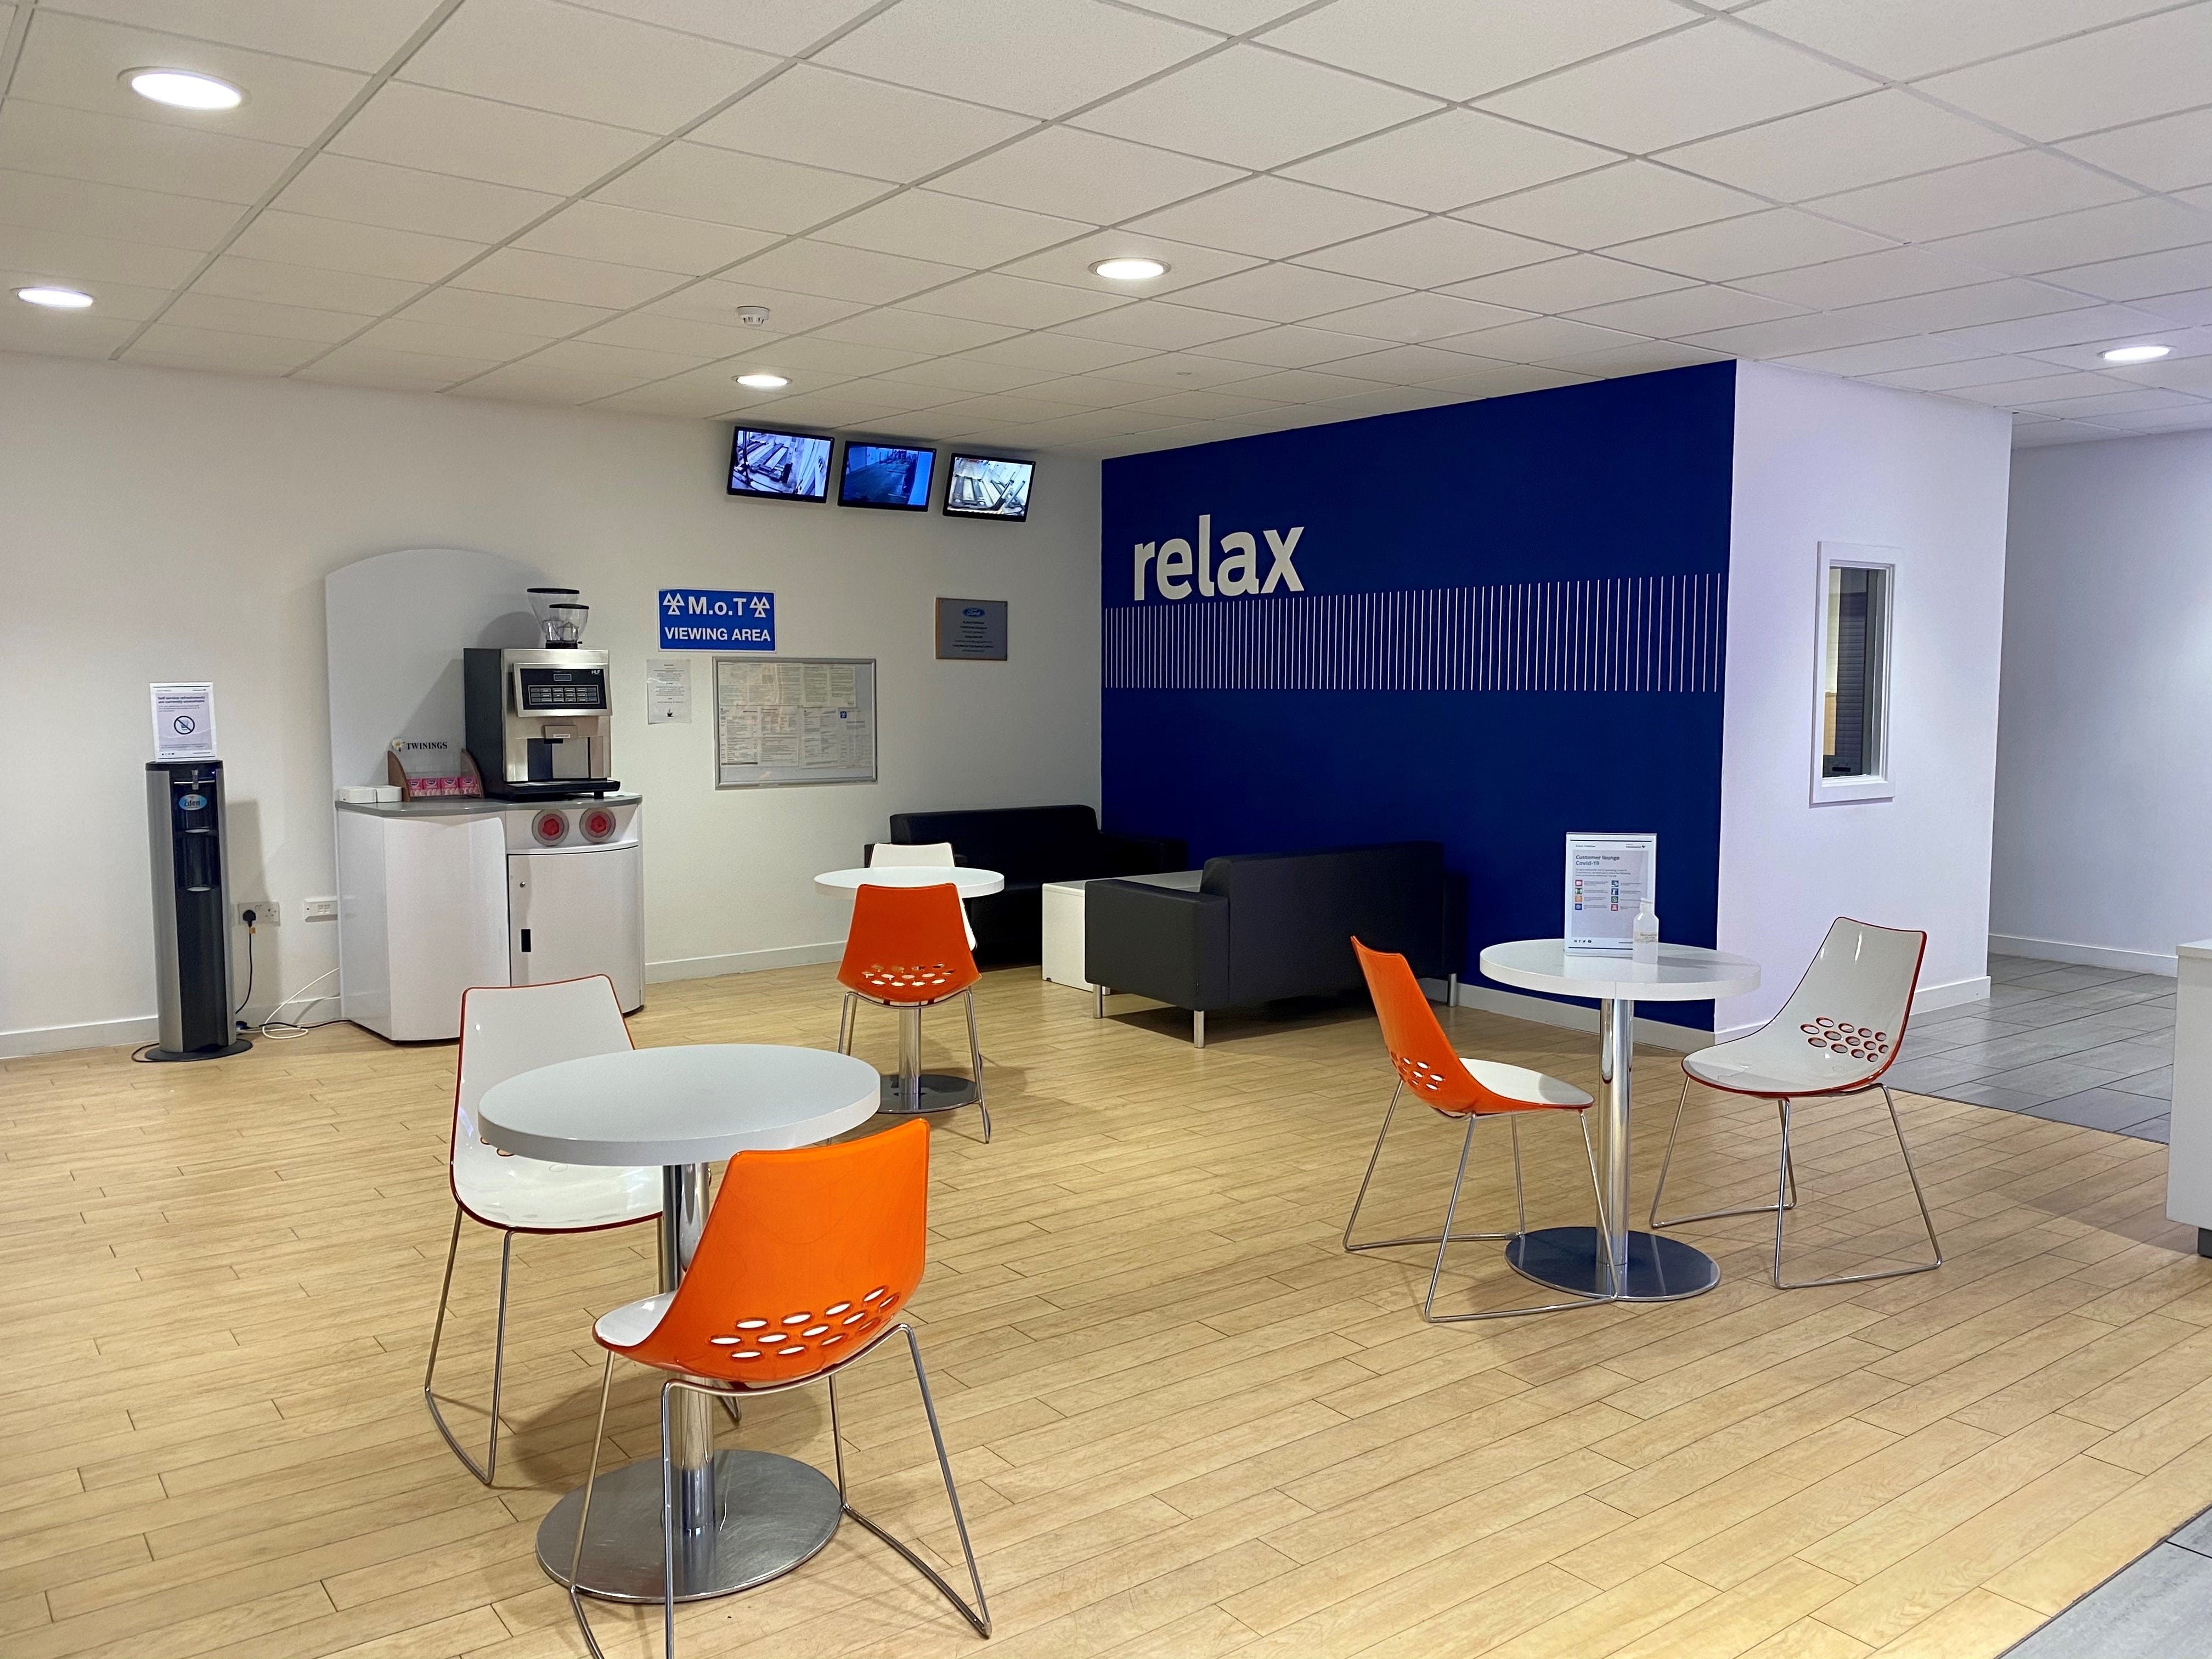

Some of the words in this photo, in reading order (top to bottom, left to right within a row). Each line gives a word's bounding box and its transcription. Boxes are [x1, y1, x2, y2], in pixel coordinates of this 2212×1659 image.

[1134, 514, 1305, 601] relax
[688, 596, 747, 616] M.o.T
[664, 627, 727, 640] VIEWING
[731, 629, 771, 641] AREA
[406, 742, 448, 750] TWININGS
